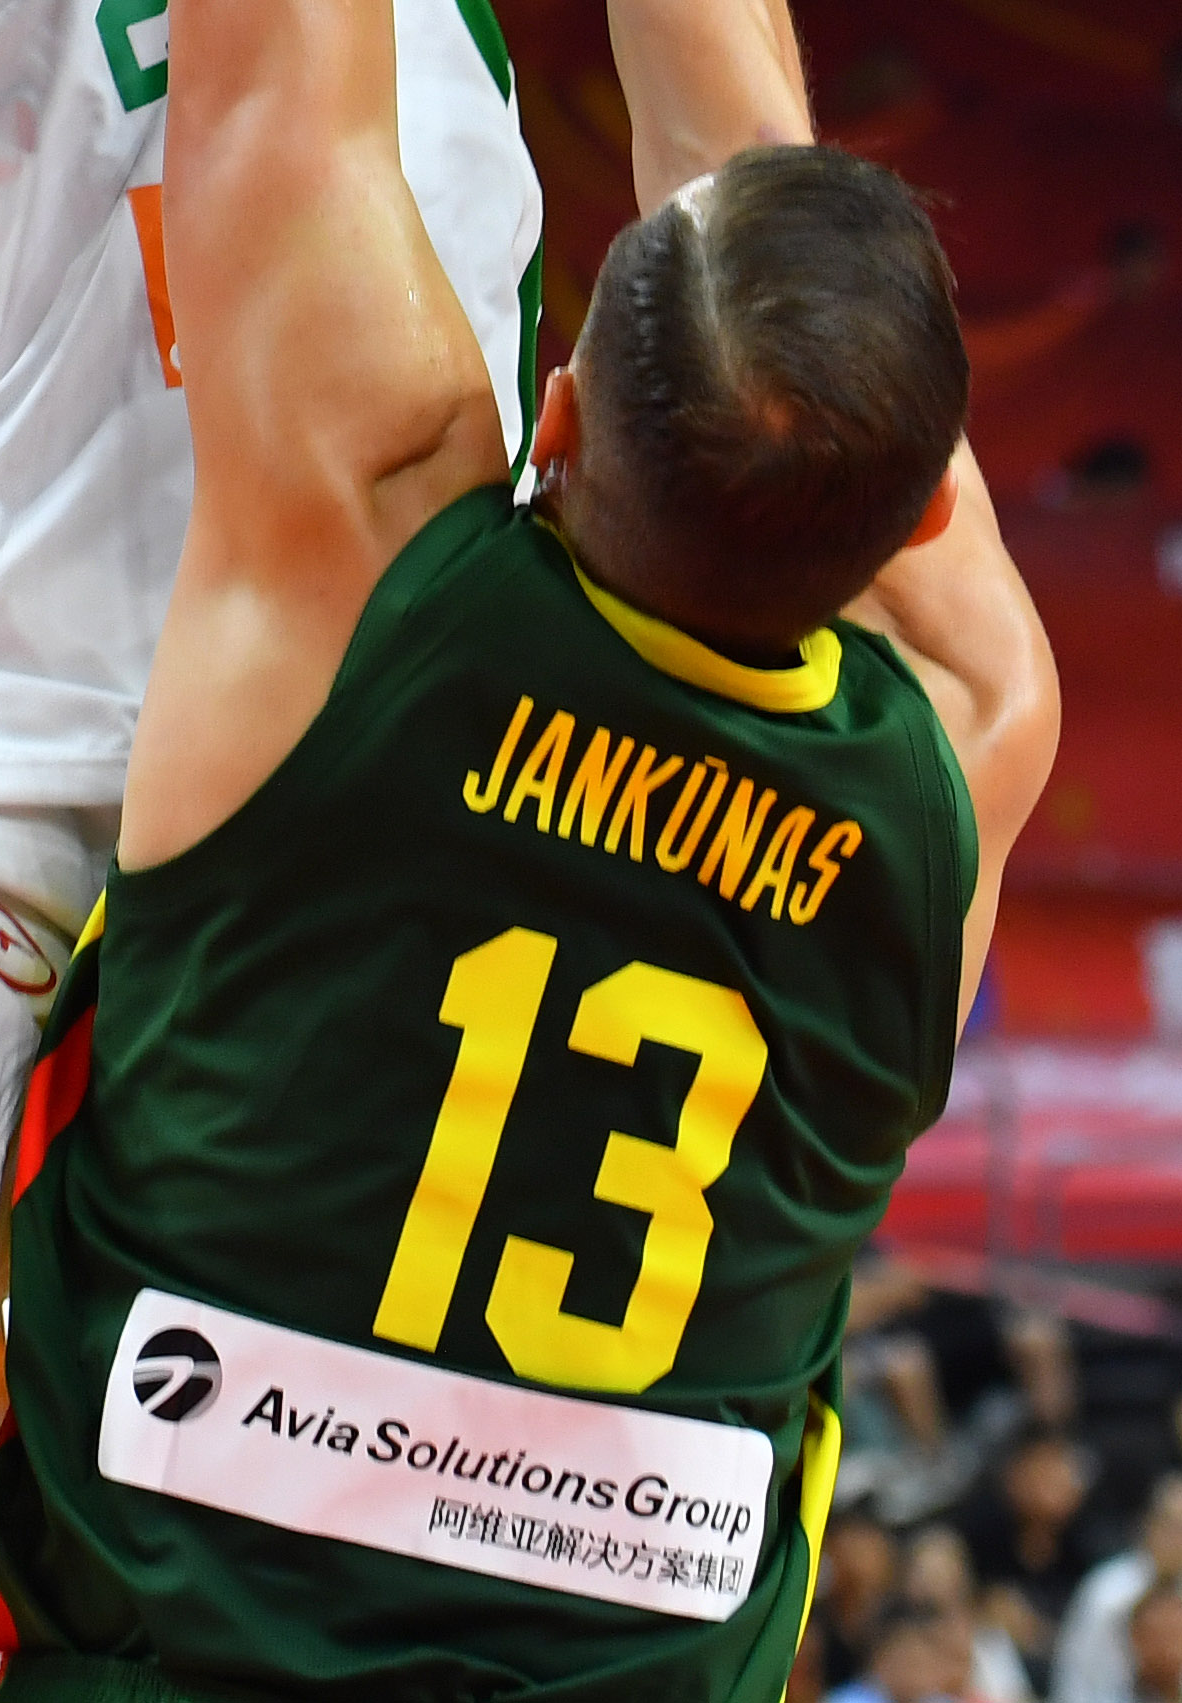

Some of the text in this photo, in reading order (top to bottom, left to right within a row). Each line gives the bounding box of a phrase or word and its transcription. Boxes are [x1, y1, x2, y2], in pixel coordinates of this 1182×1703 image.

[462, 694, 863, 926] JANKŪNAS
[373, 925, 768, 1394] 13
[428, 1495, 745, 1596] 阿维亚解决方案集团
